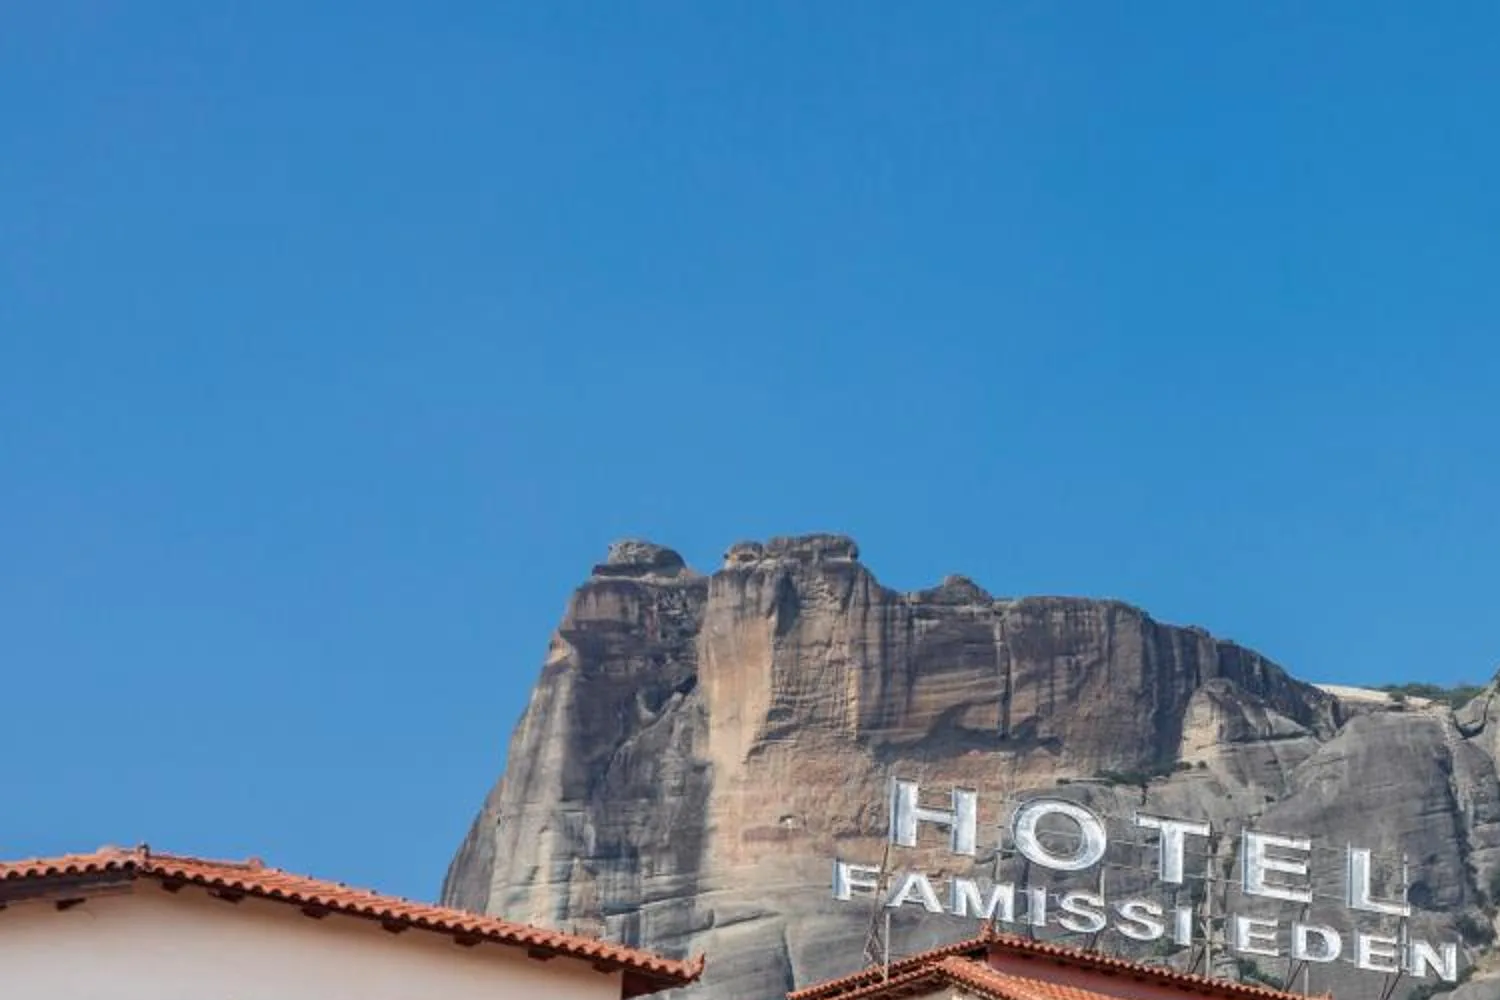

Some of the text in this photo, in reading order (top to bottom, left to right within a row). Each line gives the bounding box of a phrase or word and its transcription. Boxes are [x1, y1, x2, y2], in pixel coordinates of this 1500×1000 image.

[890, 775, 1410, 916] HOTEL
[833, 858, 1457, 982] FAMISSI EDEN
